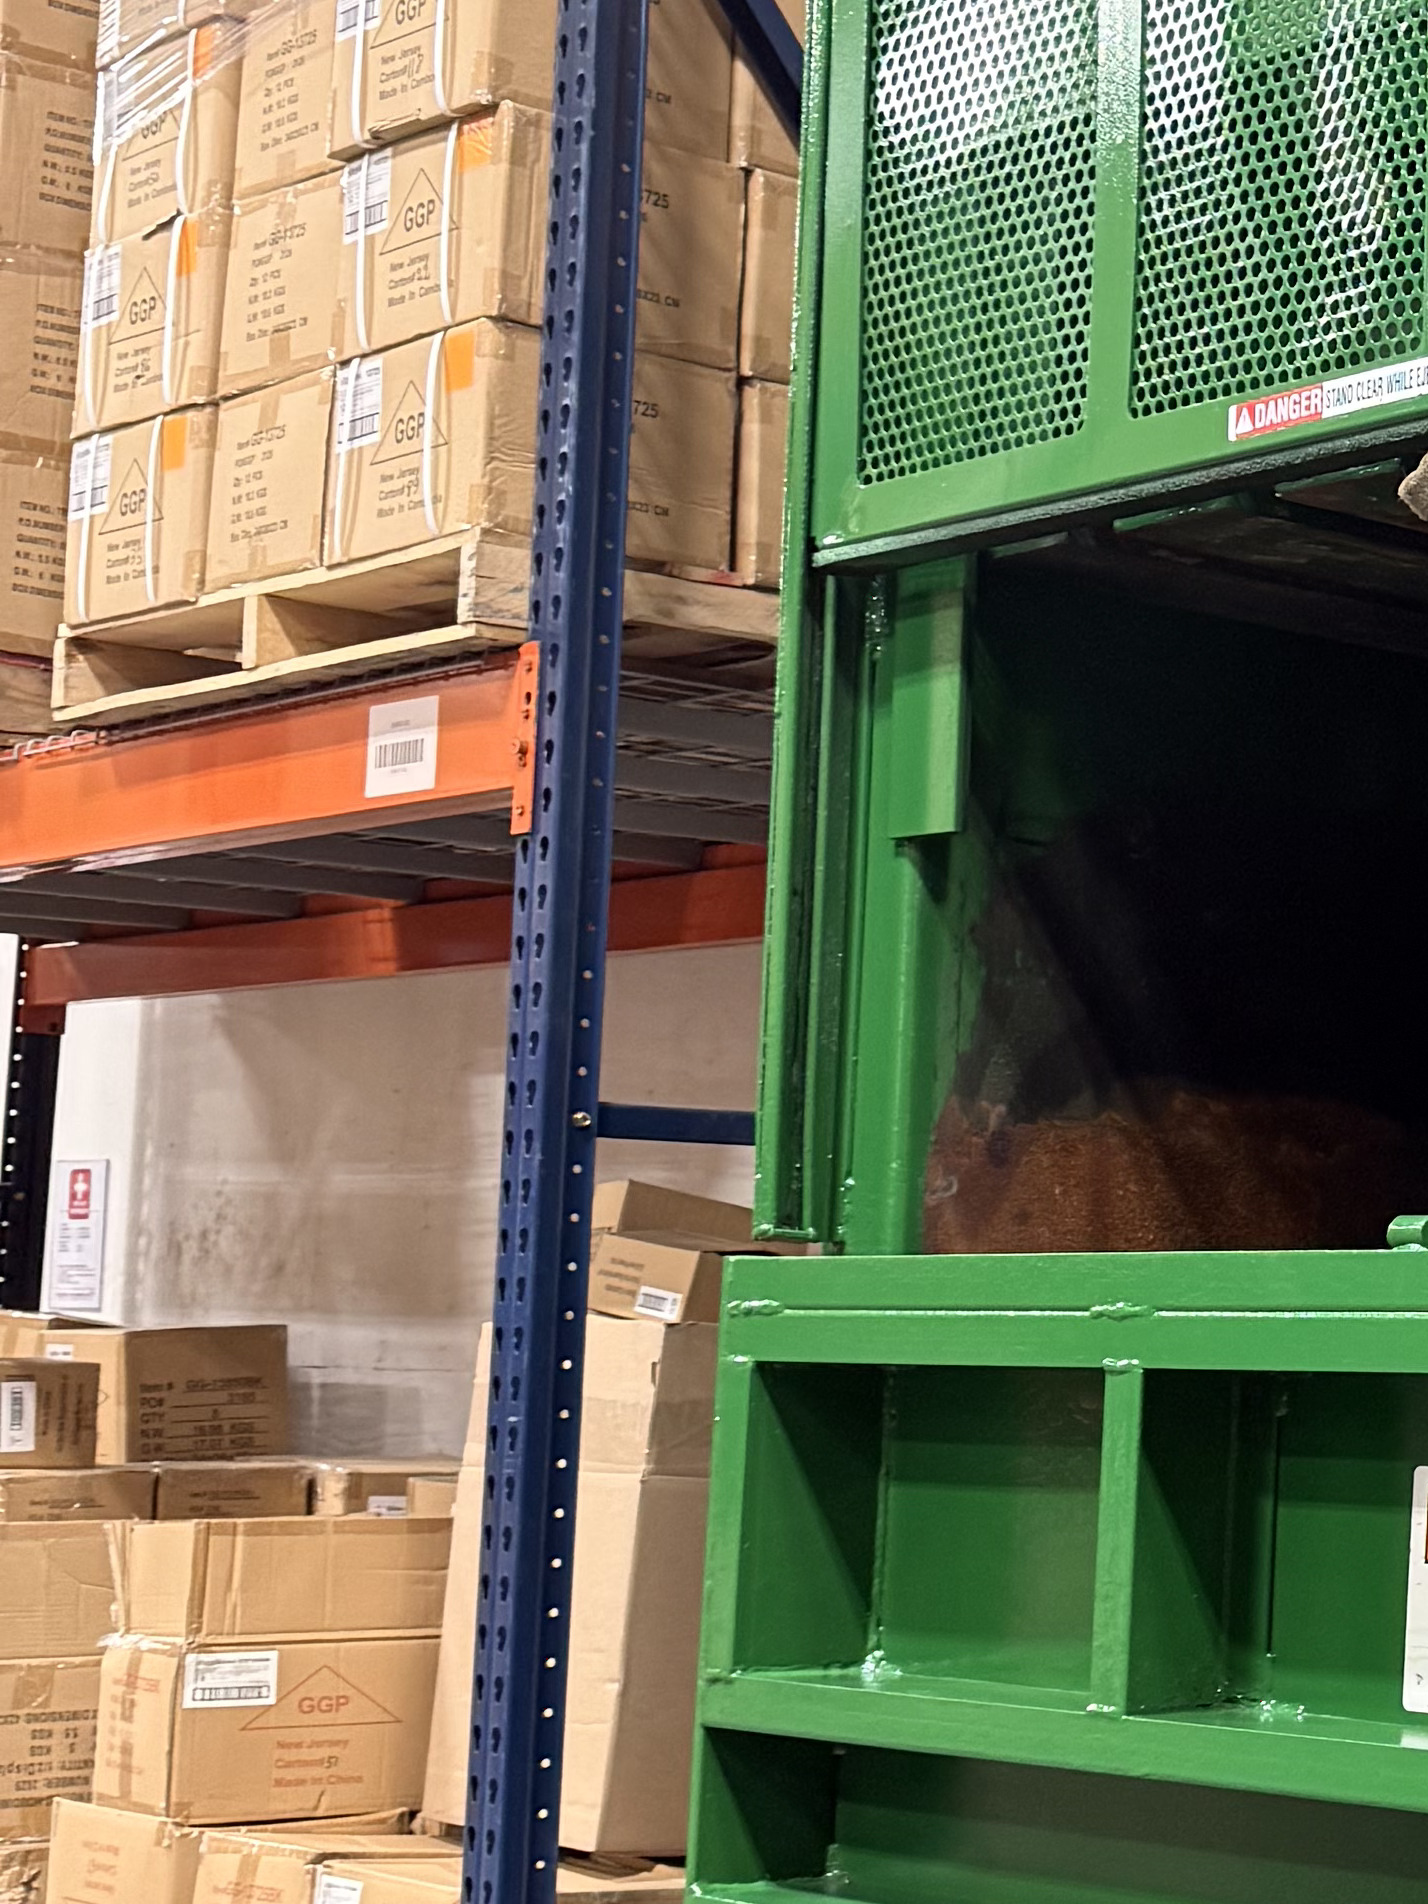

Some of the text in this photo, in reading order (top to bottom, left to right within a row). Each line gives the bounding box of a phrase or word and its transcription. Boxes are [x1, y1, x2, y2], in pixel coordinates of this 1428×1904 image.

[403, 198, 437, 233] GGP
[406, 253, 430, 268] Jersey
[129, 295, 157, 327] GGP
[1254, 388, 1322, 430] DANGER
[1326, 383, 1354, 410] STAND
[1356, 377, 1384, 404] CLEAR
[1386, 368, 1413, 394] WHILE
[394, 412, 426, 445] GGP
[119, 487, 146, 518] GGP
[297, 1695, 350, 1715] GGP
[303, 1738, 350, 1750] Jersey
